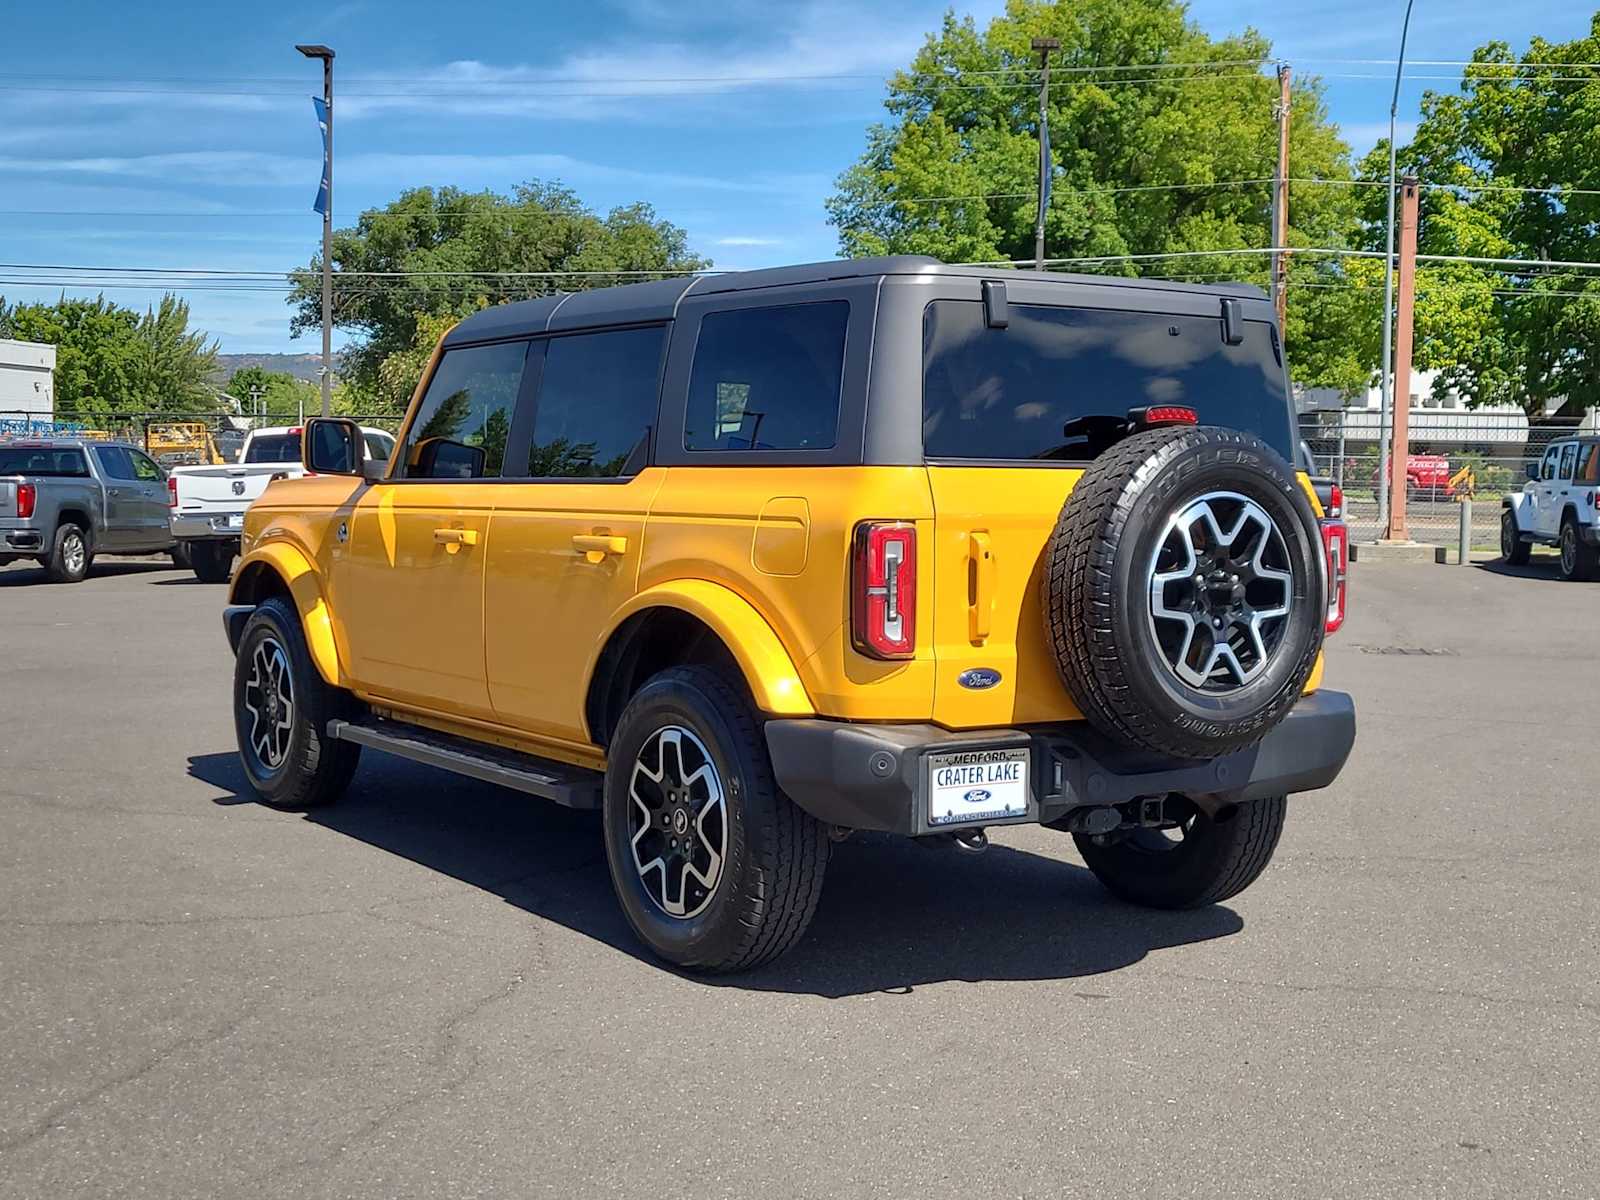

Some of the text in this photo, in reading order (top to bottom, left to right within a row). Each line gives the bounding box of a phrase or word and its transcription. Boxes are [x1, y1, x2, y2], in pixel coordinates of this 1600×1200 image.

[965, 671, 995, 688] Ford
[953, 752, 1006, 764] MEDFORD
[937, 763, 1020, 787] CRATER LAKE
